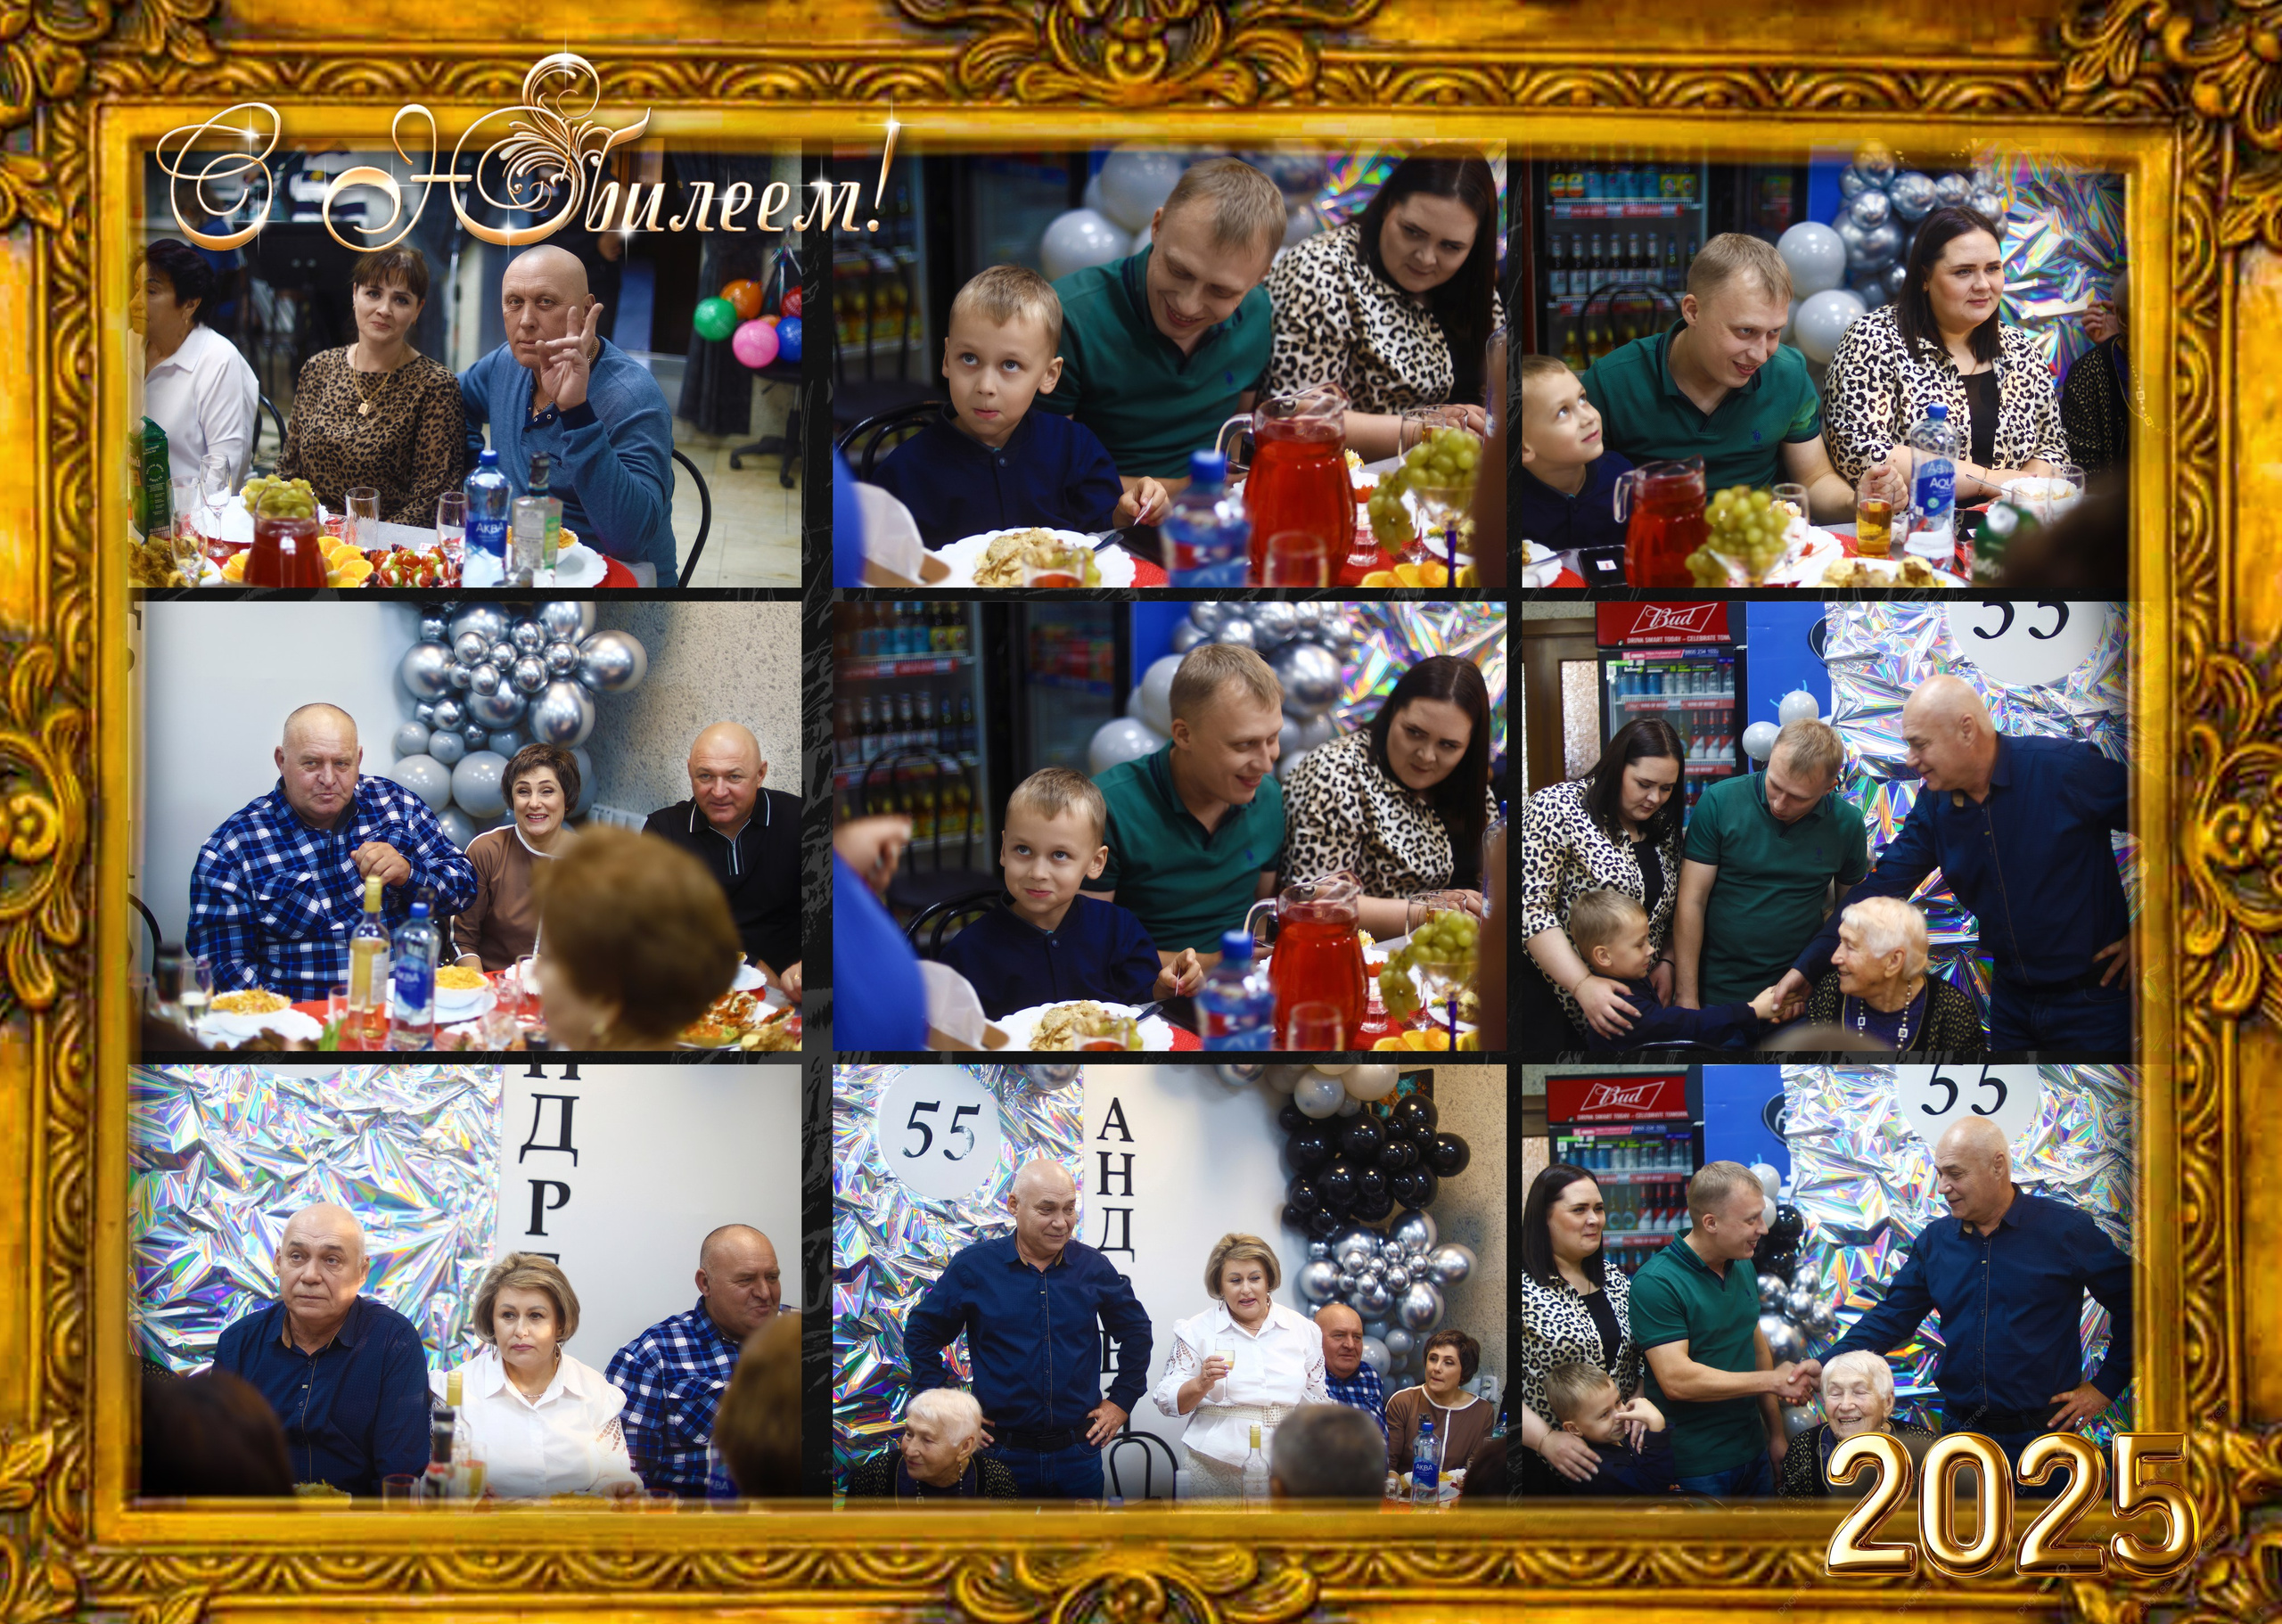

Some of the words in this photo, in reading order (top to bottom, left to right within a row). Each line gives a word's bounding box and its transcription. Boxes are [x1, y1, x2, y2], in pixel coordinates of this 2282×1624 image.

[475, 521, 505, 535] АКВА
[1646, 607, 1695, 627] Bud
[1595, 1085, 1645, 1105] Bud
[1921, 1064, 2007, 1115] 55
[899, 1100, 981, 1161] 55
[519, 1064, 581, 1265] ДР
[1416, 1464, 1433, 1472] АКВА
